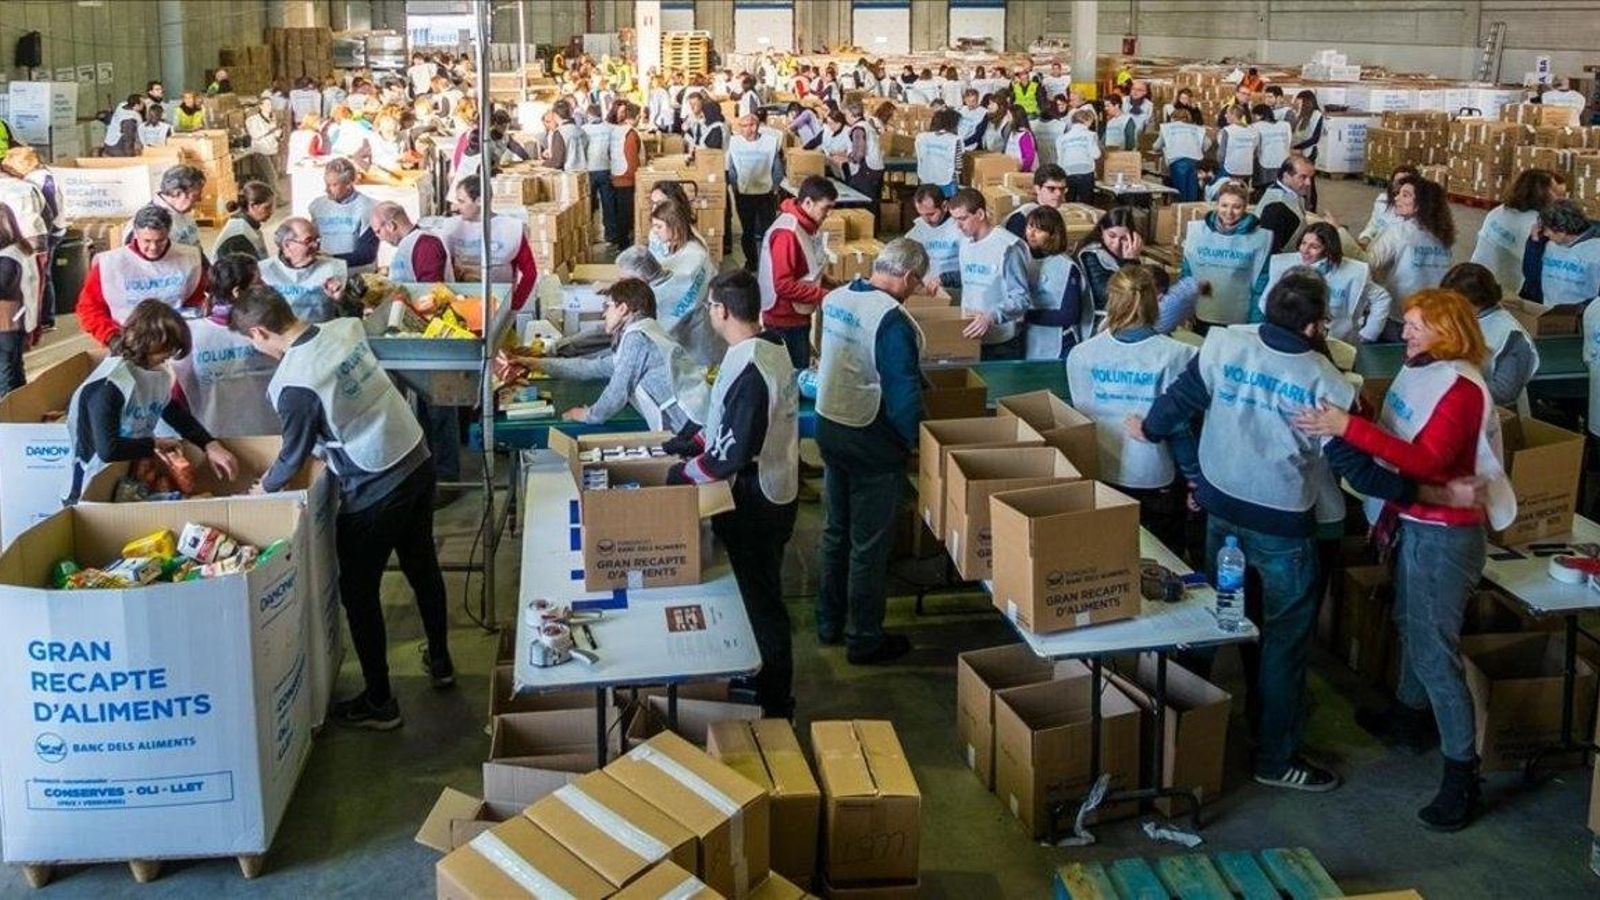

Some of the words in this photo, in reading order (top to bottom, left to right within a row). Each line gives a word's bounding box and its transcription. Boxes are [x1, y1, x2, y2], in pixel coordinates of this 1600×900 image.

[28, 640, 111, 662] GRAN
[31, 668, 167, 693] RECAPTE
[33, 694, 212, 723] D'ALIMENTS
[73, 743, 104, 753] BANC
[108, 741, 135, 752] DELS
[138, 736, 196, 750] ALIMENTS
[44, 787, 125, 798] CONSERVES
[136, 784, 159, 795] OLI
[170, 781, 204, 793] LLET
